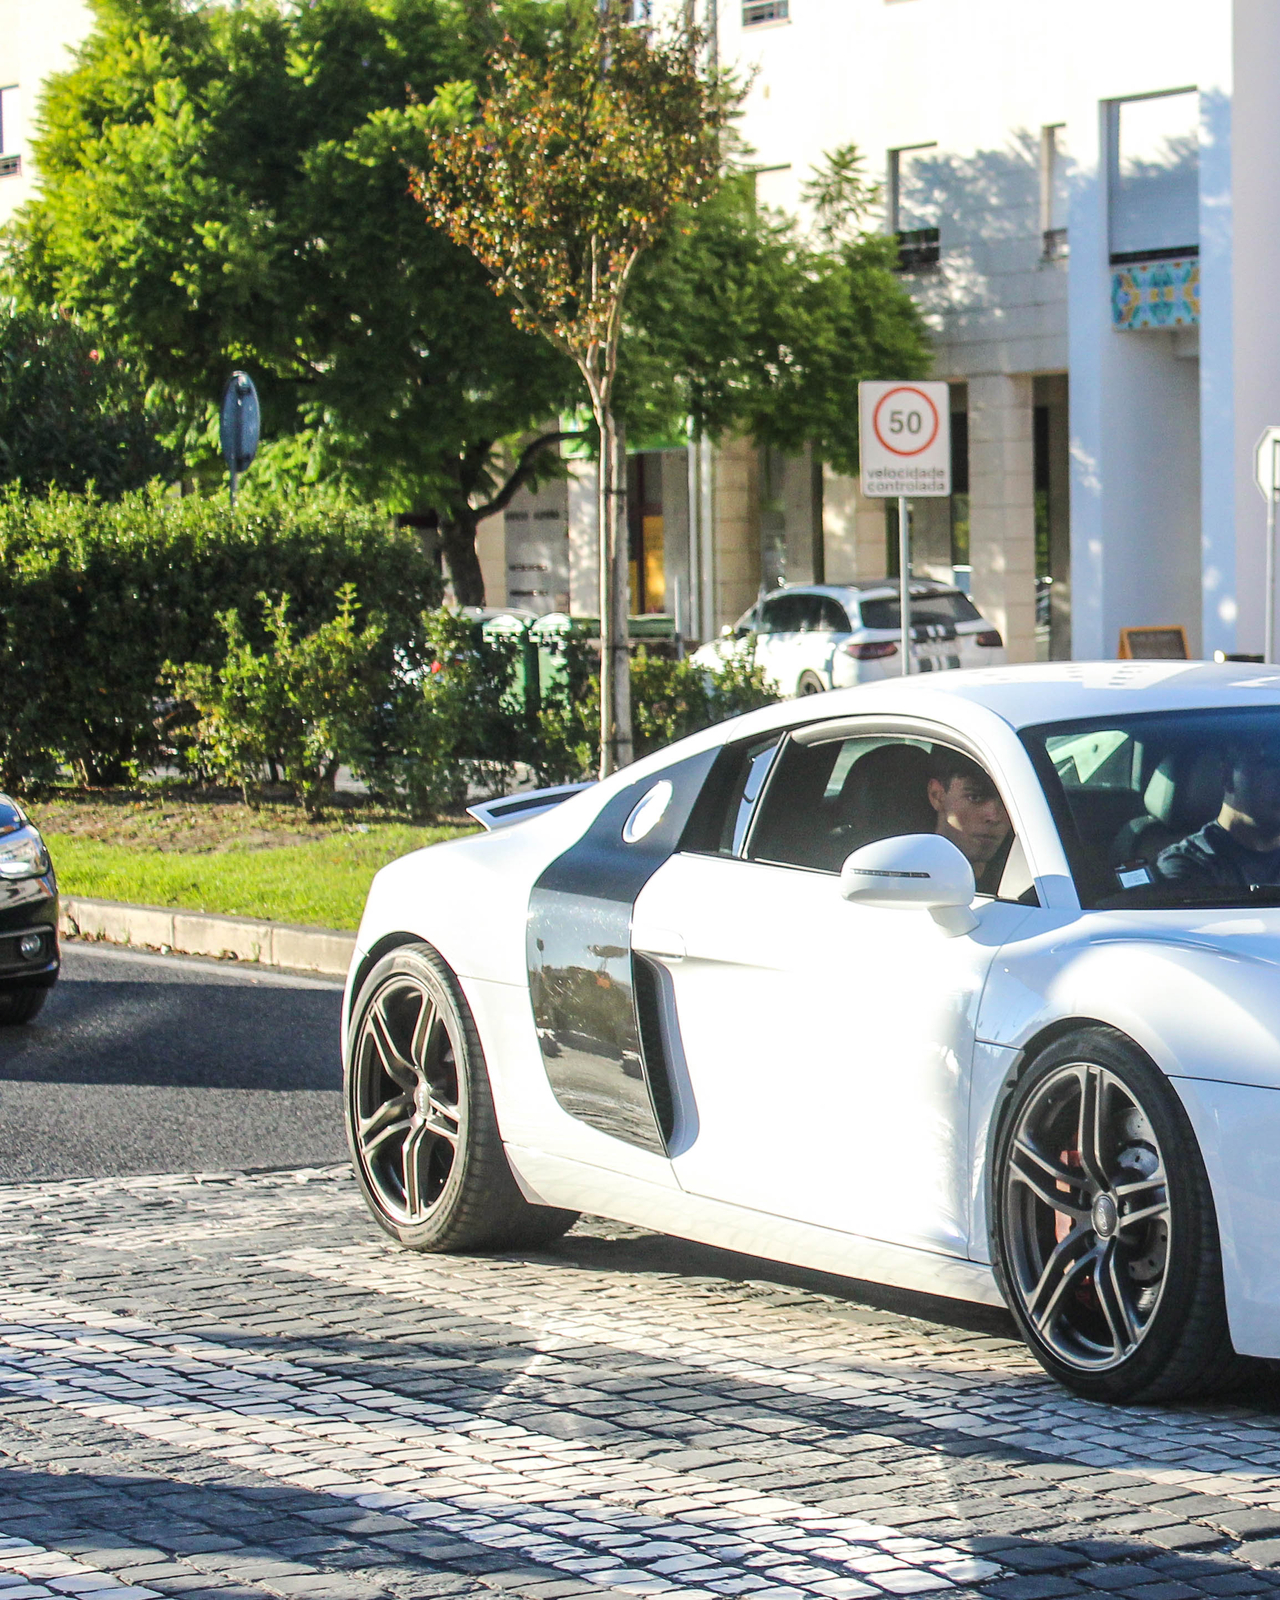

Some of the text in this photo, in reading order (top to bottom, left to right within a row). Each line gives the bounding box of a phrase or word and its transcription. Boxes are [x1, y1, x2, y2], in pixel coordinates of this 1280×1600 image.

[889, 411, 922, 434] 50
[867, 467, 945, 479] velocidade
[867, 481, 945, 493] controlada
